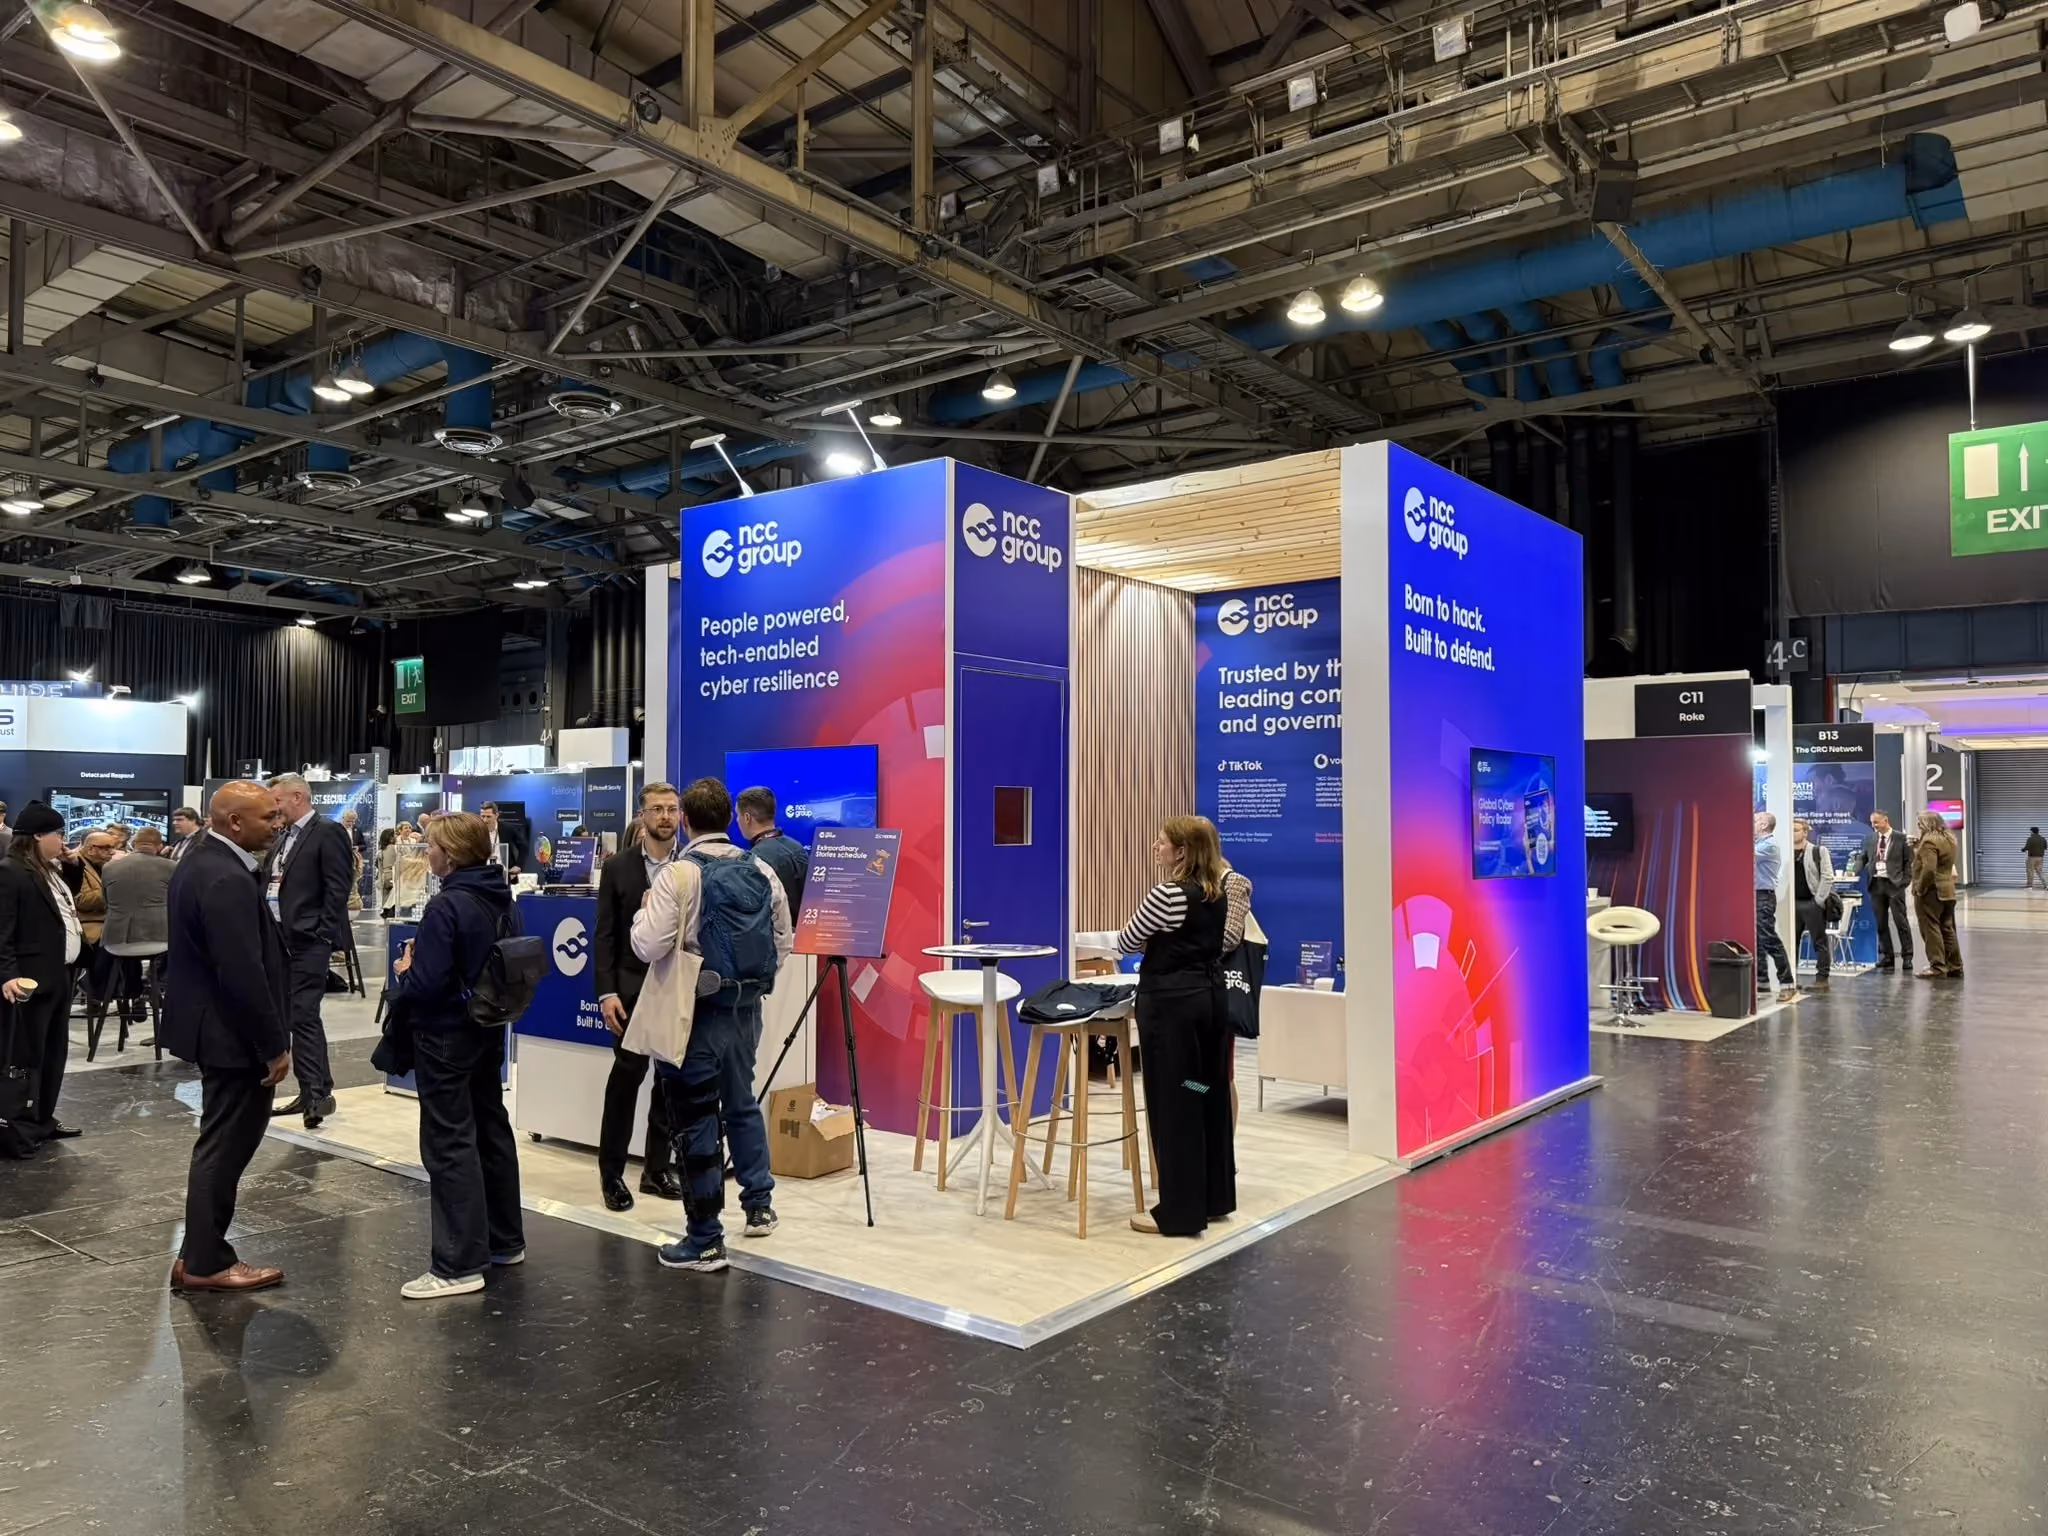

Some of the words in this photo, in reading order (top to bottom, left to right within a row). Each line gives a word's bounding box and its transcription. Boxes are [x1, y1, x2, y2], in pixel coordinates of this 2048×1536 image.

[1429, 495, 1455, 526] ncc
[739, 520, 778, 546] ncc
[1002, 510, 1040, 540] ncc
[1428, 520, 1468, 560] group
[738, 539, 802, 575] group
[1001, 535, 1062, 573] group
[1254, 593, 1295, 612] ncc
[1404, 583, 1433, 617] Born
[1436, 594, 1449, 622] to
[1452, 599, 1486, 632] hack.
[701, 611, 759, 638] People
[763, 599, 850, 635] powered,
[1253, 608, 1318, 634] group
[700, 634, 820, 667] tech-enabled
[1404, 624, 1432, 656] Built
[1435, 632, 1447, 660] to
[1450, 638, 1495, 671] defend.
[1218, 662, 1287, 685] Trusted
[1294, 661, 1320, 683] by
[700, 675, 749, 701] cyber
[753, 669, 840, 693] resilience
[401, 692, 417, 705] EXIT
[1219, 688, 1294, 710] leading
[1679, 691, 1704, 704] C11
[1219, 713, 1257, 733] and
[1679, 712, 1705, 721] Roke
[1818, 731, 1839, 740] B13
[1829, 745, 1863, 753] Network
[1229, 761, 1262, 771] TikTok
[1926, 764, 1943, 791] 2
[795, 810, 813, 818] group
[1479, 798, 1497, 810] Global
[1479, 813, 1495, 828] Policy
[813, 866, 826, 876] 22
[804, 909, 818, 918] 23
[580, 1000, 599, 1012] Born
[576, 1016, 593, 1028] Built
[594, 1019, 603, 1029] to
